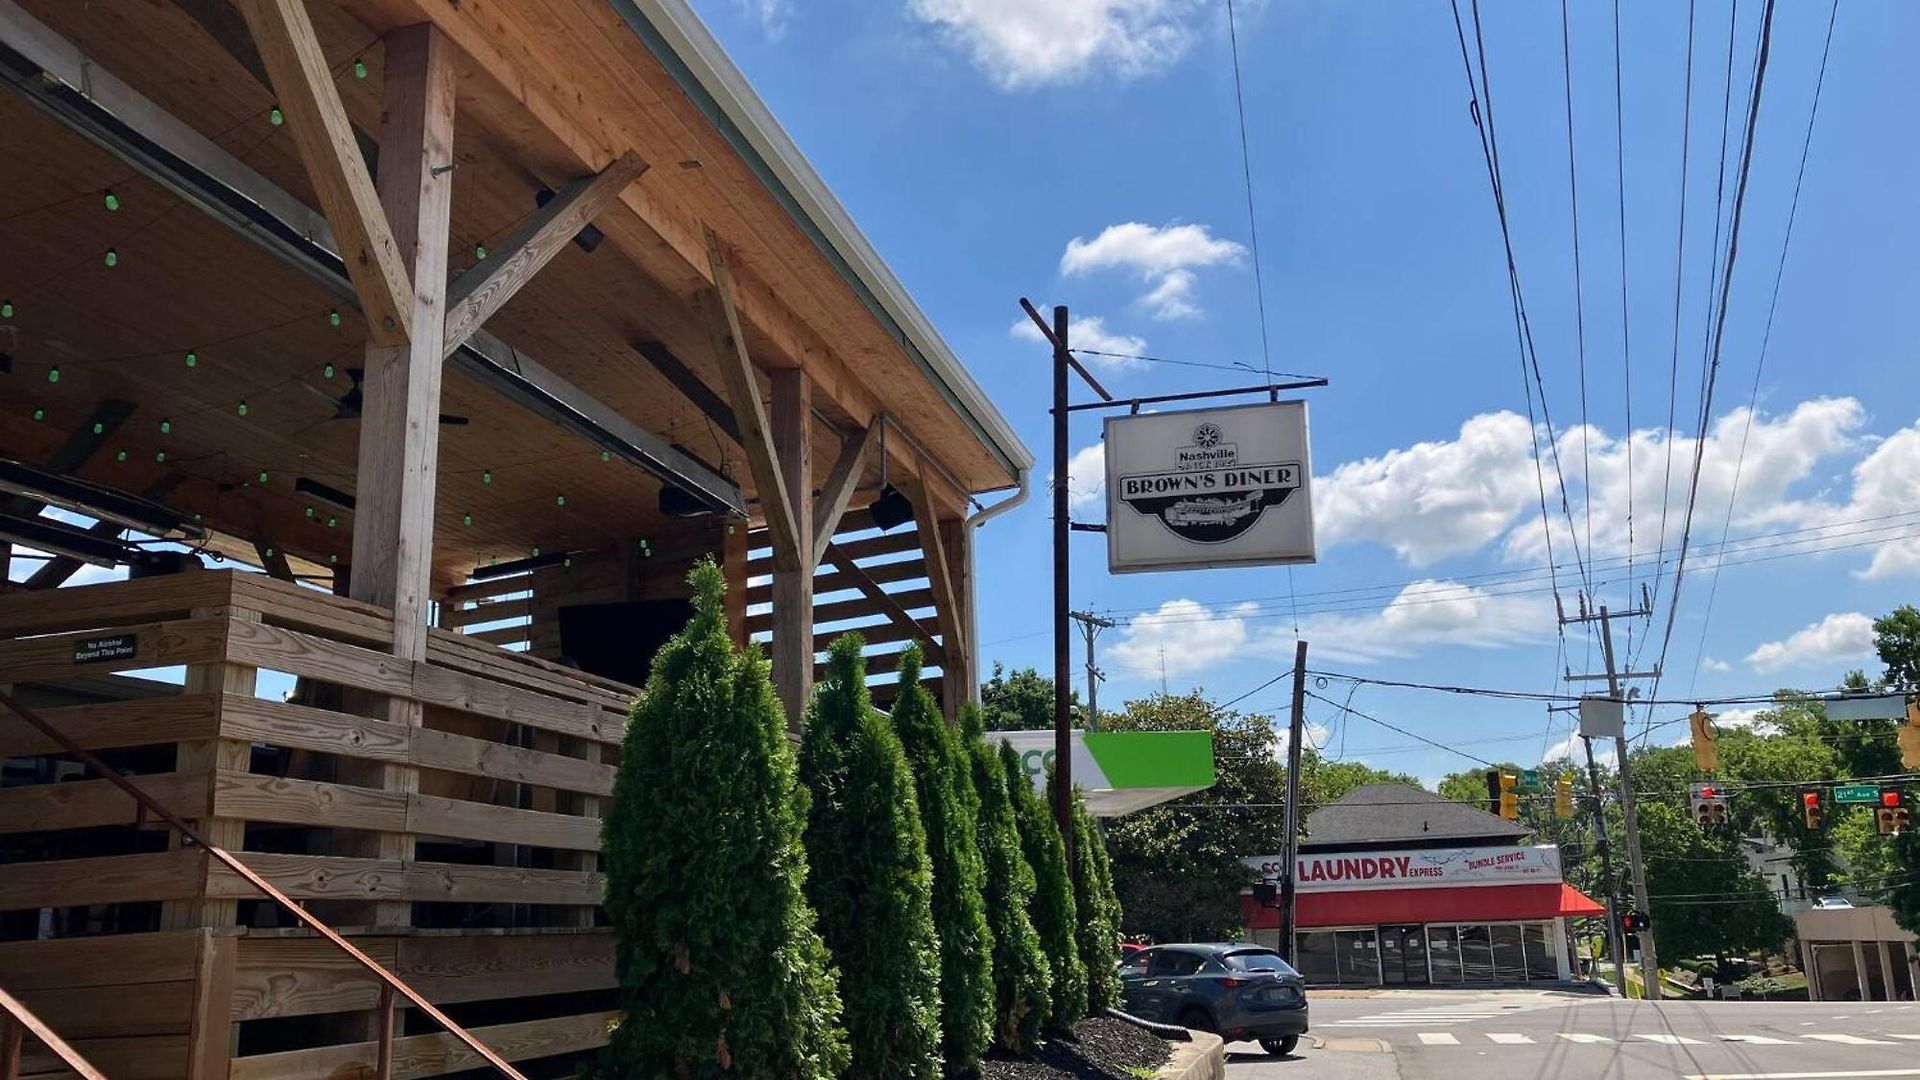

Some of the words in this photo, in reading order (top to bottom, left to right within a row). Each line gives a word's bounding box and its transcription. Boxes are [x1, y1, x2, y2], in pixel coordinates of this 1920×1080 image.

[1179, 449, 1235, 461] Nashville
[1127, 473, 1216, 495] BROWN'S
[1224, 468, 1292, 487] DINER
[101, 648, 115, 656] This
[116, 646, 133, 655] Point
[1496, 850, 1525, 865] SERVICE
[1298, 856, 1411, 882] LAUNDRY
[1410, 866, 1443, 878] EXPRESS
